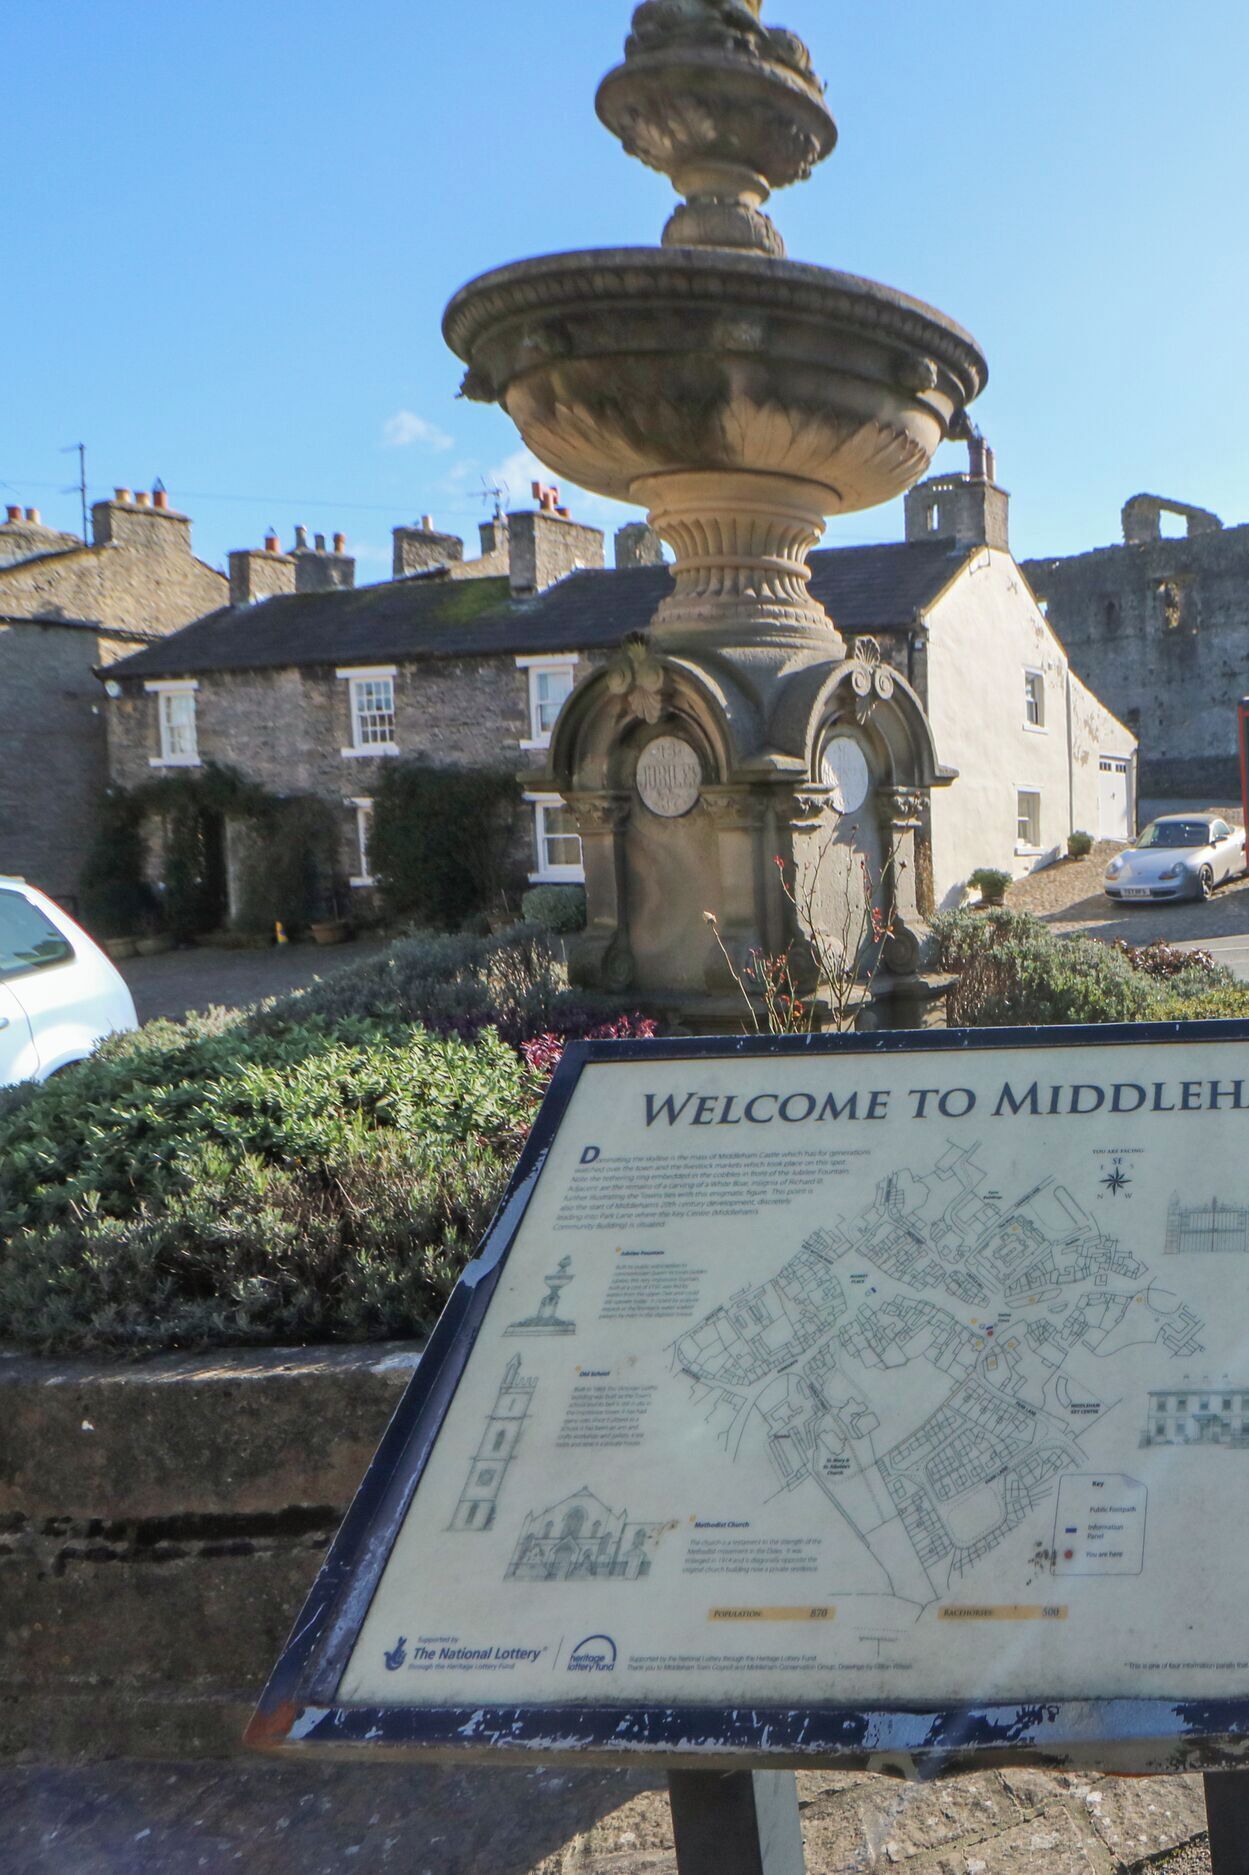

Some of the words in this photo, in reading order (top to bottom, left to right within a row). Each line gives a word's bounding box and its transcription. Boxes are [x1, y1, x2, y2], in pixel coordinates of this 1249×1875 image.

[644, 1090, 890, 1127] WELCOME
[908, 1088, 976, 1119] TO
[759, 1151, 779, 1159] Castle
[782, 1150, 803, 1158] which
[829, 1149, 871, 1157] generations
[783, 1160, 803, 1168] place
[603, 1174, 635, 1183] tethering
[637, 1174, 650, 1182] ring
[651, 1172, 689, 1181] embedded
[668, 1182, 694, 1191] carving
[788, 1178, 816, 1186] Richard
[709, 1189, 743, 1197] enigmatic
[600, 1212, 615, 1220] Park
[671, 1210, 685, 1219] Key
[552, 1223, 594, 1232] Community
[1092, 1480, 1104, 1488] Key
[1109, 1505, 1136, 1514] Footpath
[1088, 1523, 1123, 1531] Information
[714, 1610, 762, 1618] POPULATION
[810, 1608, 828, 1618] 870
[943, 1609, 993, 1617] RACEHORSES
[1041, 1608, 1059, 1617] 500
[418, 1636, 447, 1645] Supported
[413, 1647, 434, 1660] The
[438, 1646, 491, 1660] National
[494, 1647, 541, 1663] Lottery
[570, 1654, 605, 1665] heritage
[408, 1662, 434, 1671] through
[447, 1662, 474, 1671] Heritage
[475, 1662, 498, 1671] Lottery
[498, 1662, 516, 1670] Fund
[567, 1662, 595, 1673] lottery
[596, 1662, 615, 1672] fund
